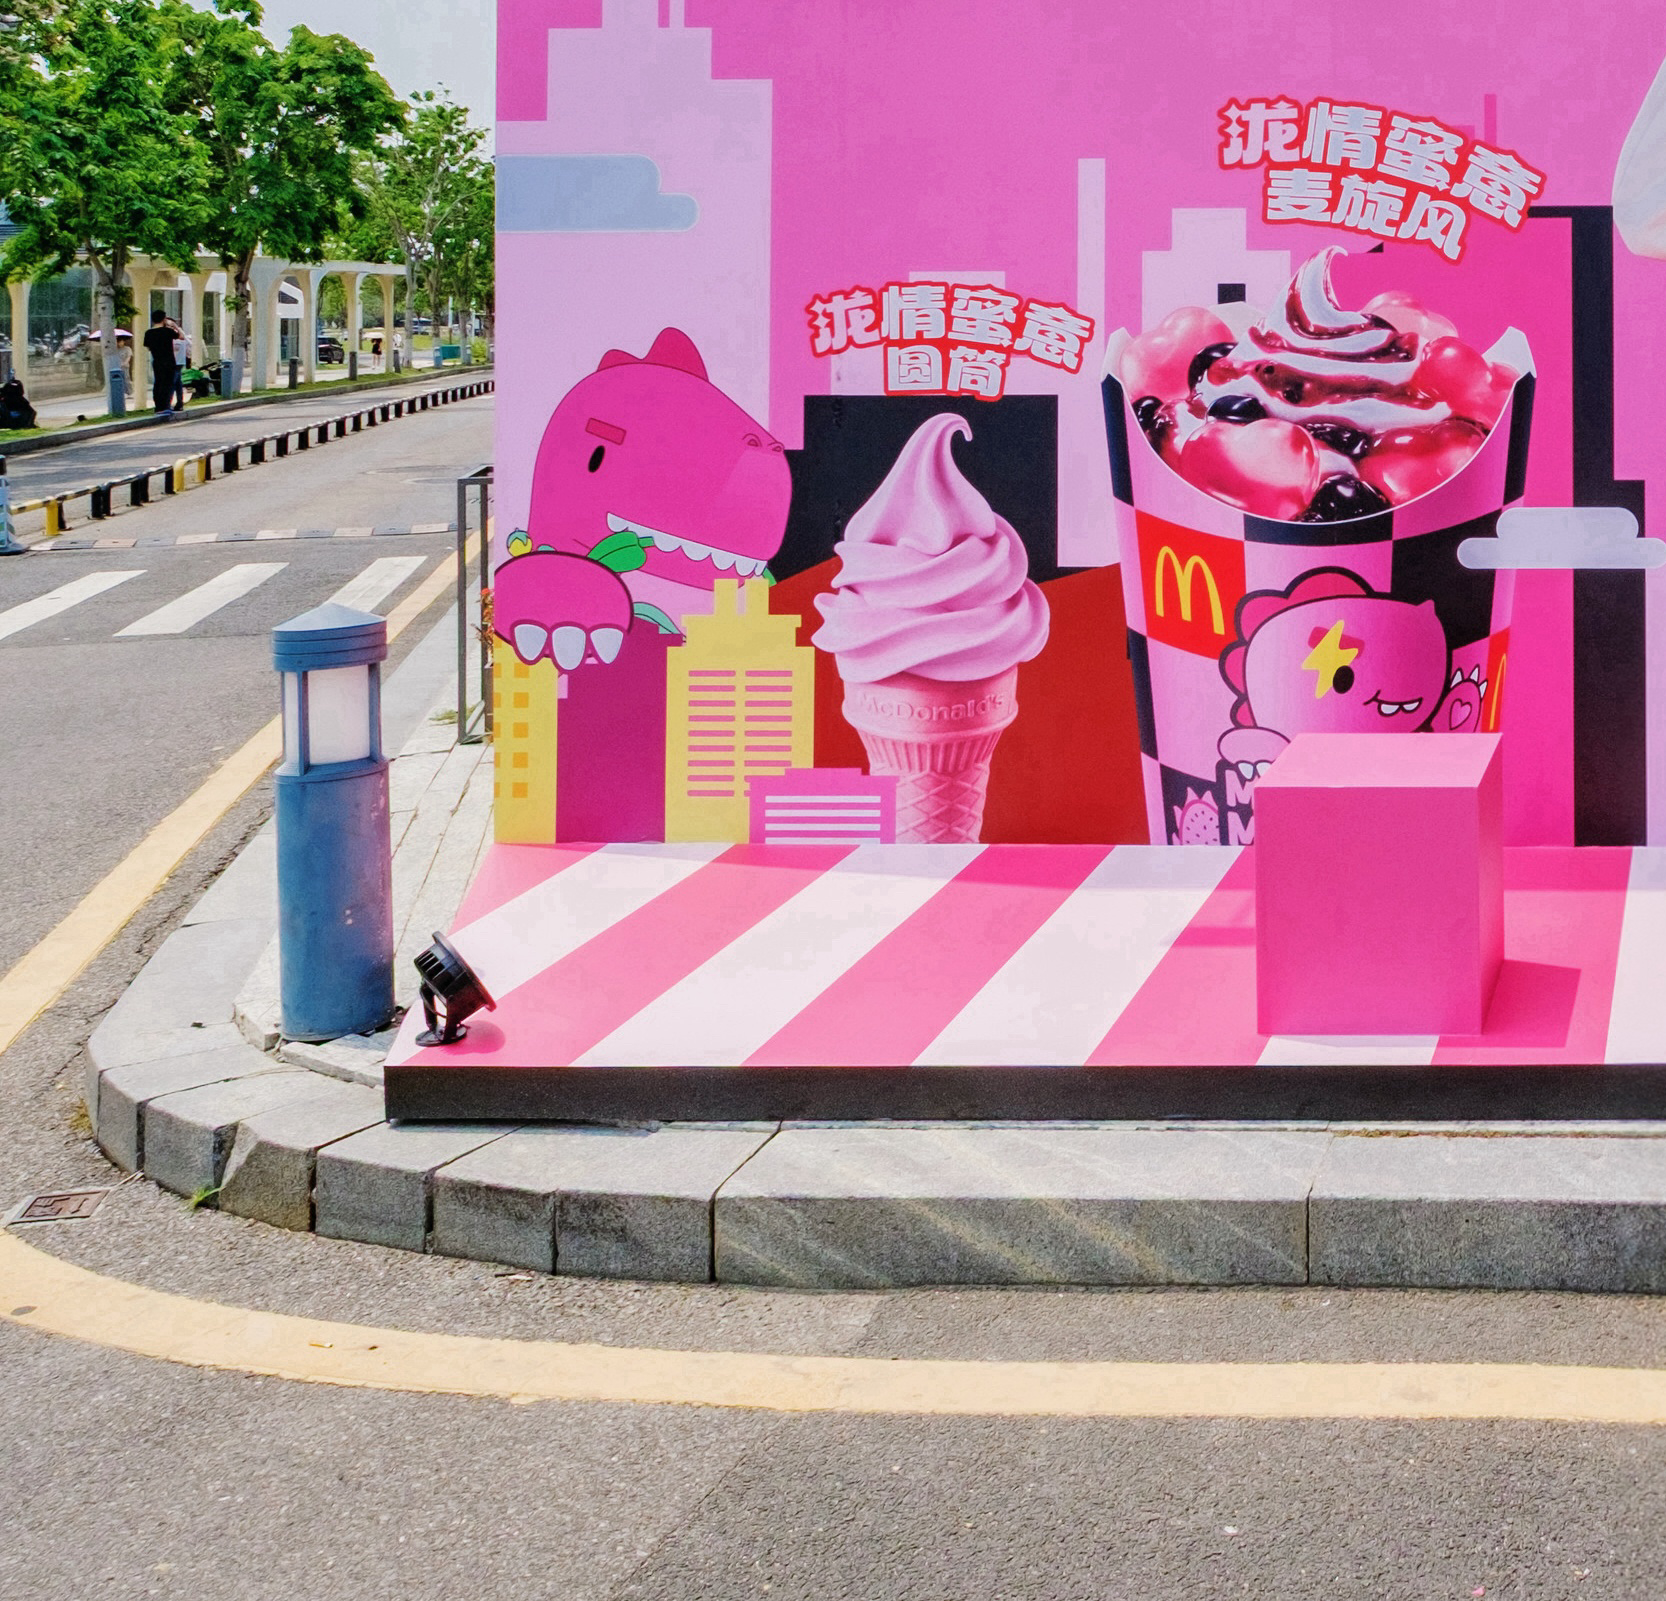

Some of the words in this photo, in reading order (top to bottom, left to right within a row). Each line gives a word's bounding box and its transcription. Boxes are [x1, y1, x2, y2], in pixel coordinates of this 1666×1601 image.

[1265, 167, 1468, 261] 麦旋风
[886, 344, 1008, 398] 圆筒
[860, 692, 1004, 722] McDonald's
